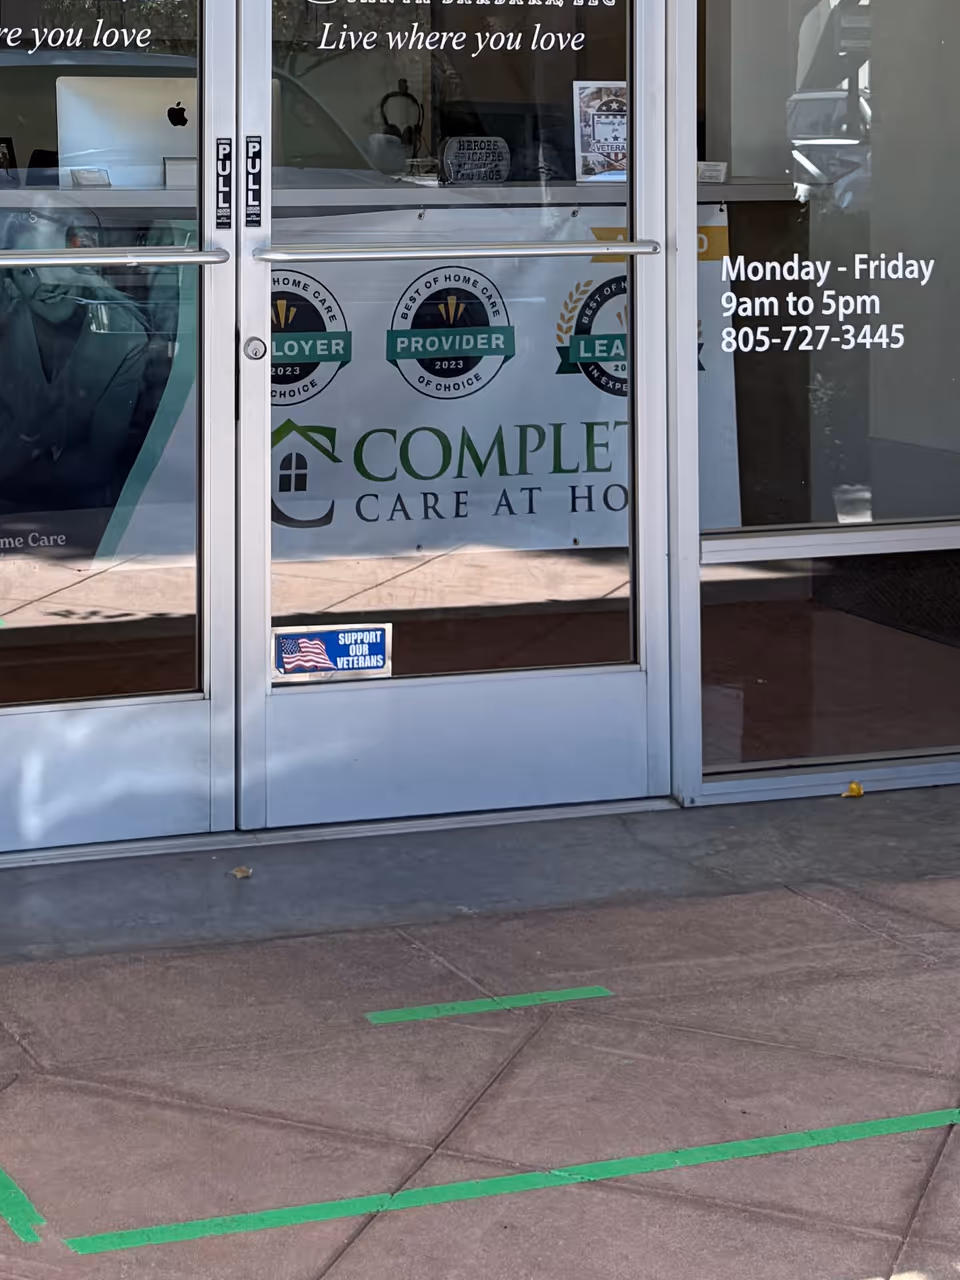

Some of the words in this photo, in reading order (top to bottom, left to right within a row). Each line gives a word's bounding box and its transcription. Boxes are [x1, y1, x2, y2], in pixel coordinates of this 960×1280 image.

[28, 25, 82, 55] you
[92, 20, 152, 48] love
[317, 22, 377, 51] Live
[385, 23, 466, 51] where
[471, 30, 522, 58] you
[531, 24, 585, 52] love
[458, 140, 499, 151] HEROES
[596, 144, 626, 152] VETERA
[217, 144, 231, 208] PULL
[247, 142, 261, 206] PULL
[721, 254, 831, 287] Monday
[854, 253, 935, 286] Friday
[272, 277, 310, 292] HOME
[312, 290, 338, 323] CARE
[400, 288, 422, 321] BEST
[424, 276, 439, 289] OF
[444, 274, 479, 289] HOME
[481, 287, 501, 318] CARE
[582, 293, 601, 324] BEST
[604, 283, 617, 295] OF
[721, 291, 779, 318] 9am
[785, 291, 815, 317] to
[821, 290, 881, 322] 5pm
[272, 339, 345, 356] LOYER
[396, 334, 505, 353] PROVIDER
[579, 339, 625, 358] LEA
[721, 324, 905, 353] 805-727-3445
[271, 366, 301, 375] 2023
[435, 360, 464, 369] 2023
[613, 363, 627, 372] 20
[417, 375, 433, 388] OF
[435, 372, 482, 392] CHOICE
[588, 364, 602, 379] IN
[600, 376, 628, 392] EXPE
[271, 378, 318, 399] CHOICE
[355, 490, 468, 522] CARE
[492, 487, 542, 517] AT
[569, 483, 629, 513] HO
[28, 532, 66, 547] Care
[338, 630, 382, 645] SUPPORT
[349, 643, 369, 656] OUR
[336, 655, 384, 669] VETERANS
